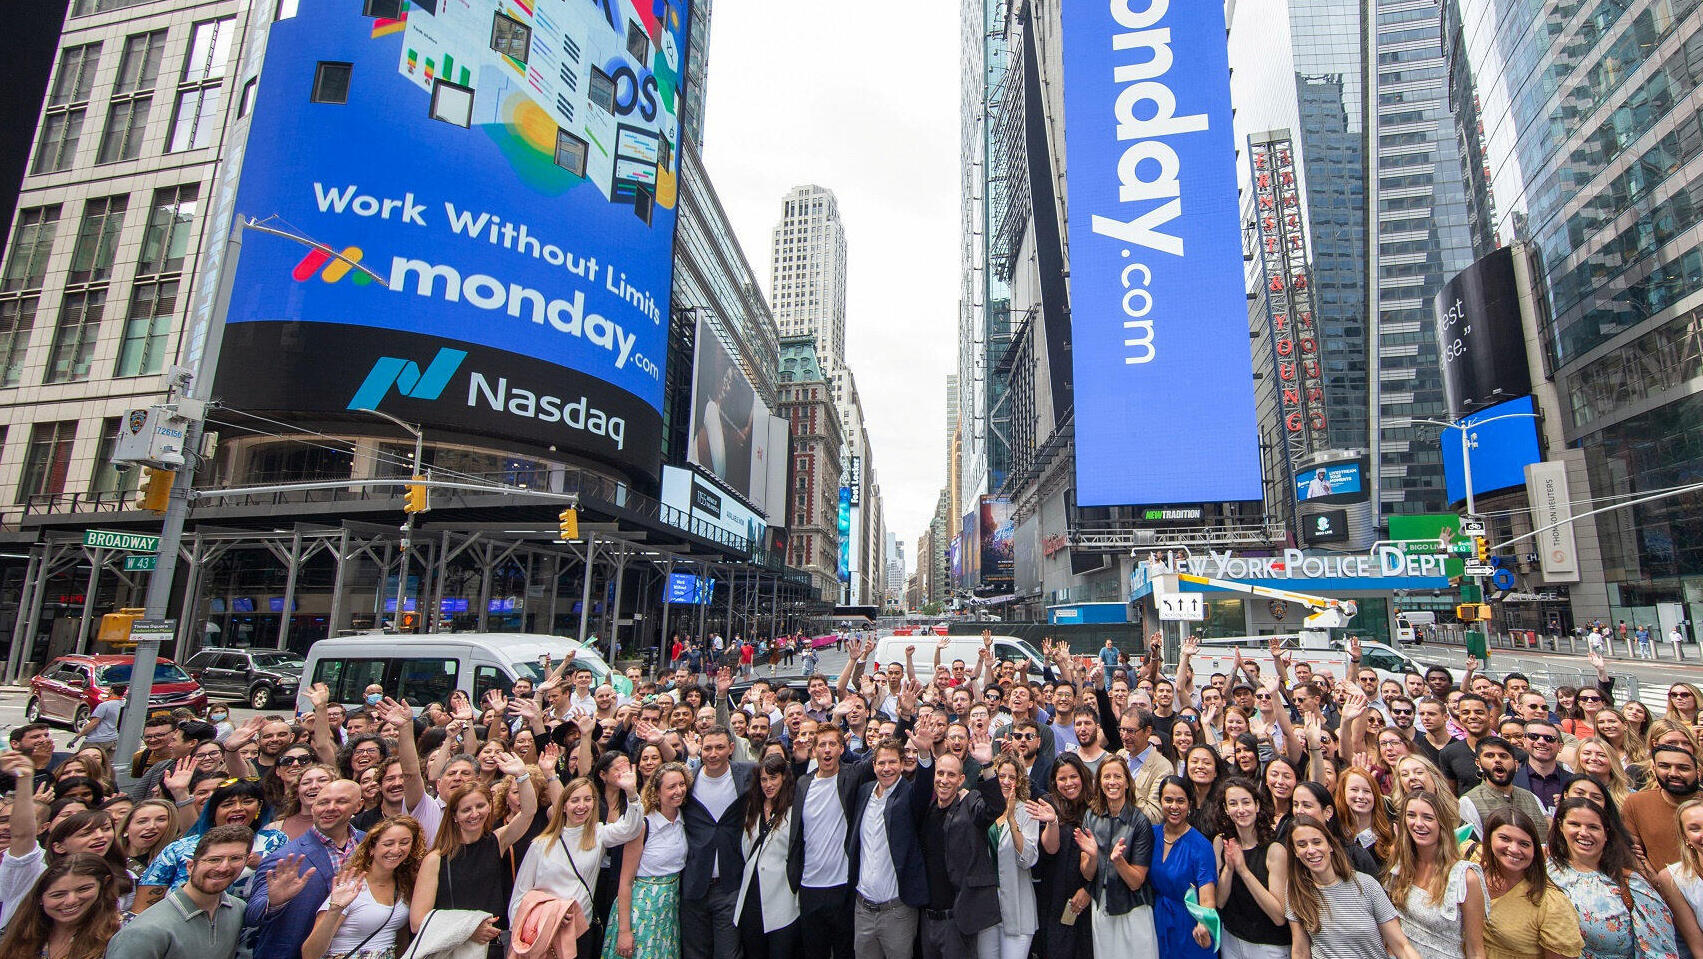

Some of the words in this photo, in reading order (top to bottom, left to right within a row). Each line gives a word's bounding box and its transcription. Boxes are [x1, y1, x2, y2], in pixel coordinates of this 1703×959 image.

[1256, 152, 1276, 248] ERNST
[313, 182, 427, 227] Work
[444, 202, 600, 277] Without
[606, 264, 661, 327] Limits
[1269, 275, 1284, 292] &
[388, 255, 659, 382] monday.com
[1273, 313, 1302, 432] YOUNG
[467, 372, 626, 451] Nasdaq
[156, 426, 183, 438] 726156
[87, 532, 156, 550] BROADWAY
[127, 557, 135, 569] W
[137, 557, 149, 569] 43
[1210, 549, 1279, 580] YORK
[1284, 548, 1370, 579] POLICE
[1379, 546, 1449, 578] DEPT
[1511, 592, 1558, 601] CHASE
